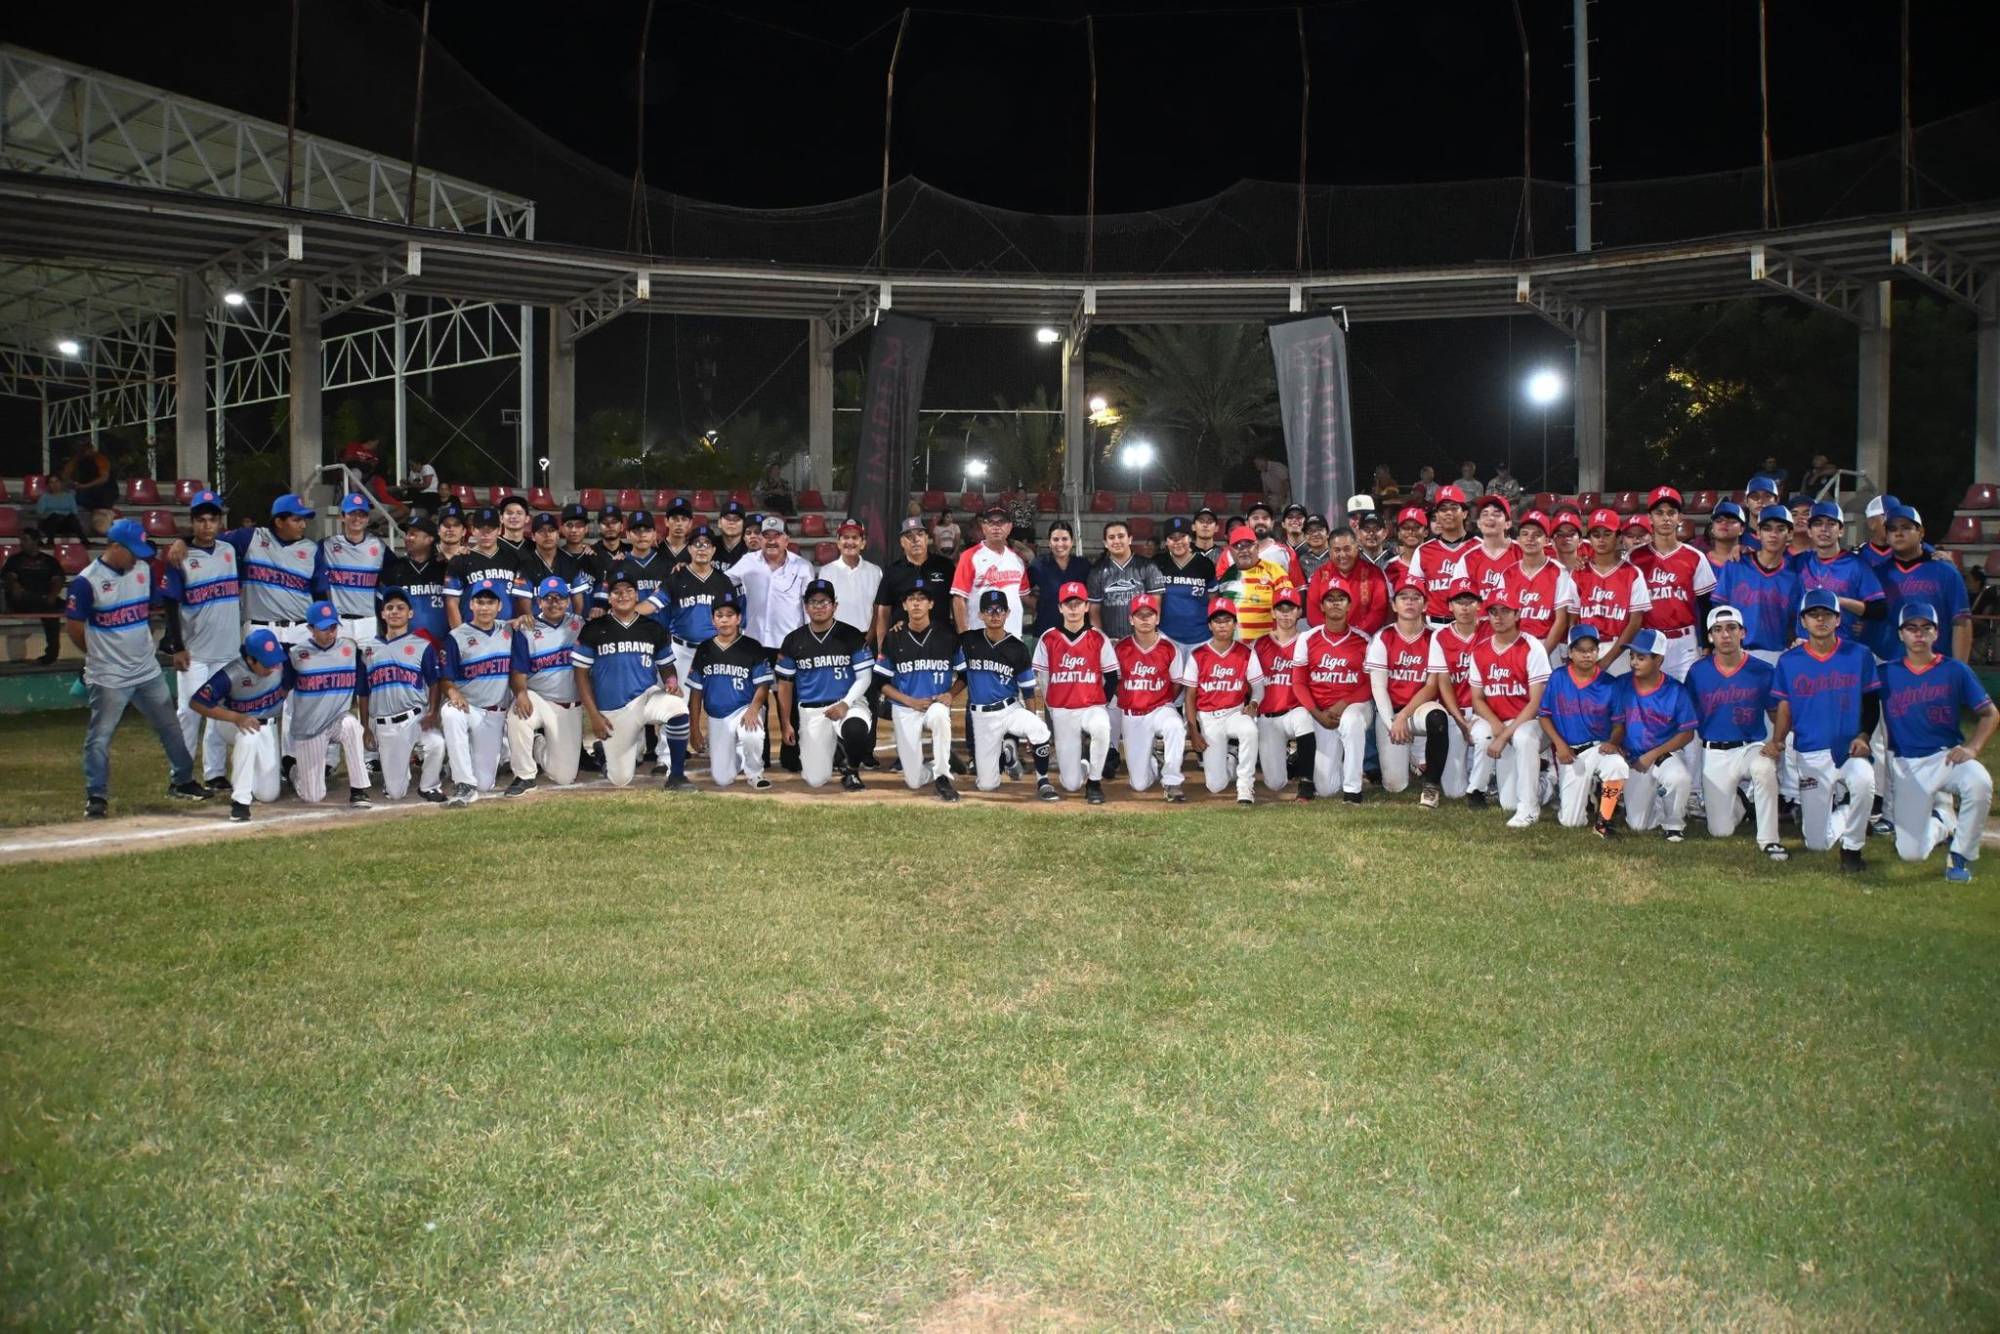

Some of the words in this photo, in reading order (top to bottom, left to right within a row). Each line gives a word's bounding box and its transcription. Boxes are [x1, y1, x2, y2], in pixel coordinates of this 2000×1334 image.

[466, 571, 483, 584] LOS
[485, 568, 513, 582] BRAVO
[410, 583, 444, 596] BRAVO
[679, 597, 695, 609] LOS
[597, 642, 615, 656] LOS
[813, 655, 850, 668] BRAVOS
[896, 661, 912, 674] LOS
[914, 659, 950, 672] BRAVOS
[1058, 653, 1086, 670] Liga
[1130, 660, 1157, 678] Liga
[1318, 653, 1348, 672] Liga
[713, 663, 750, 679] BRAVOS
[1208, 663, 1236, 681] Liga
[732, 677, 744, 691] 15
